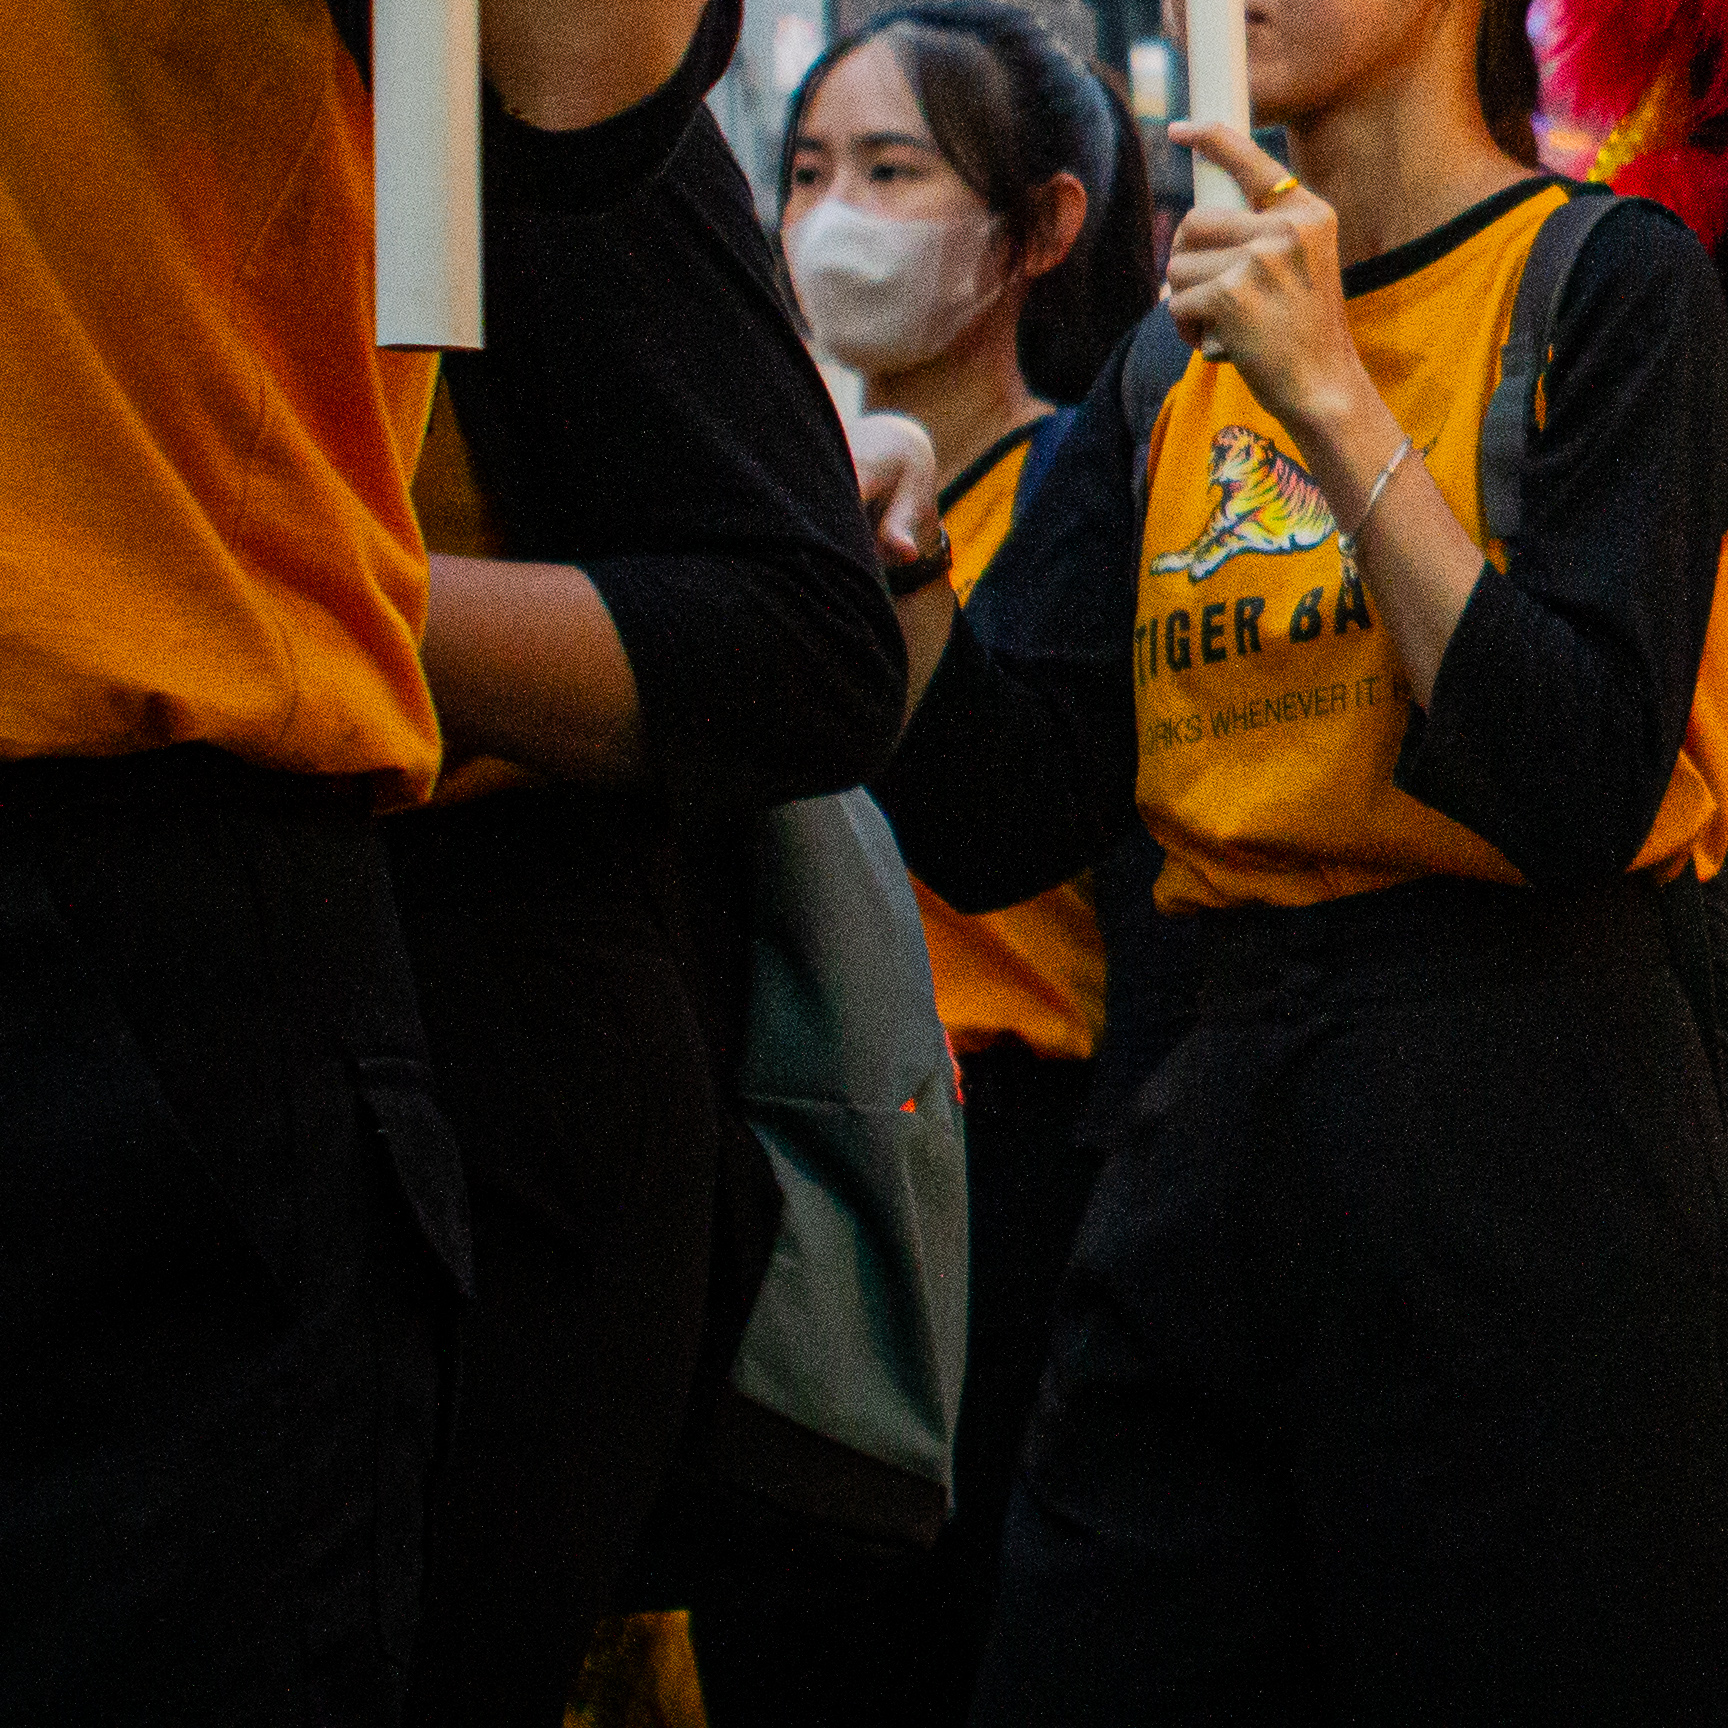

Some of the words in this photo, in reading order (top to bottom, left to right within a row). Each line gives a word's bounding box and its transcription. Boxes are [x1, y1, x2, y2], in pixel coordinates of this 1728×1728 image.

[1134, 594, 1266, 689] TIGER
[1288, 577, 1373, 647] BA
[1210, 682, 1347, 739] WHENEVER
[1354, 676, 1379, 708] IT
